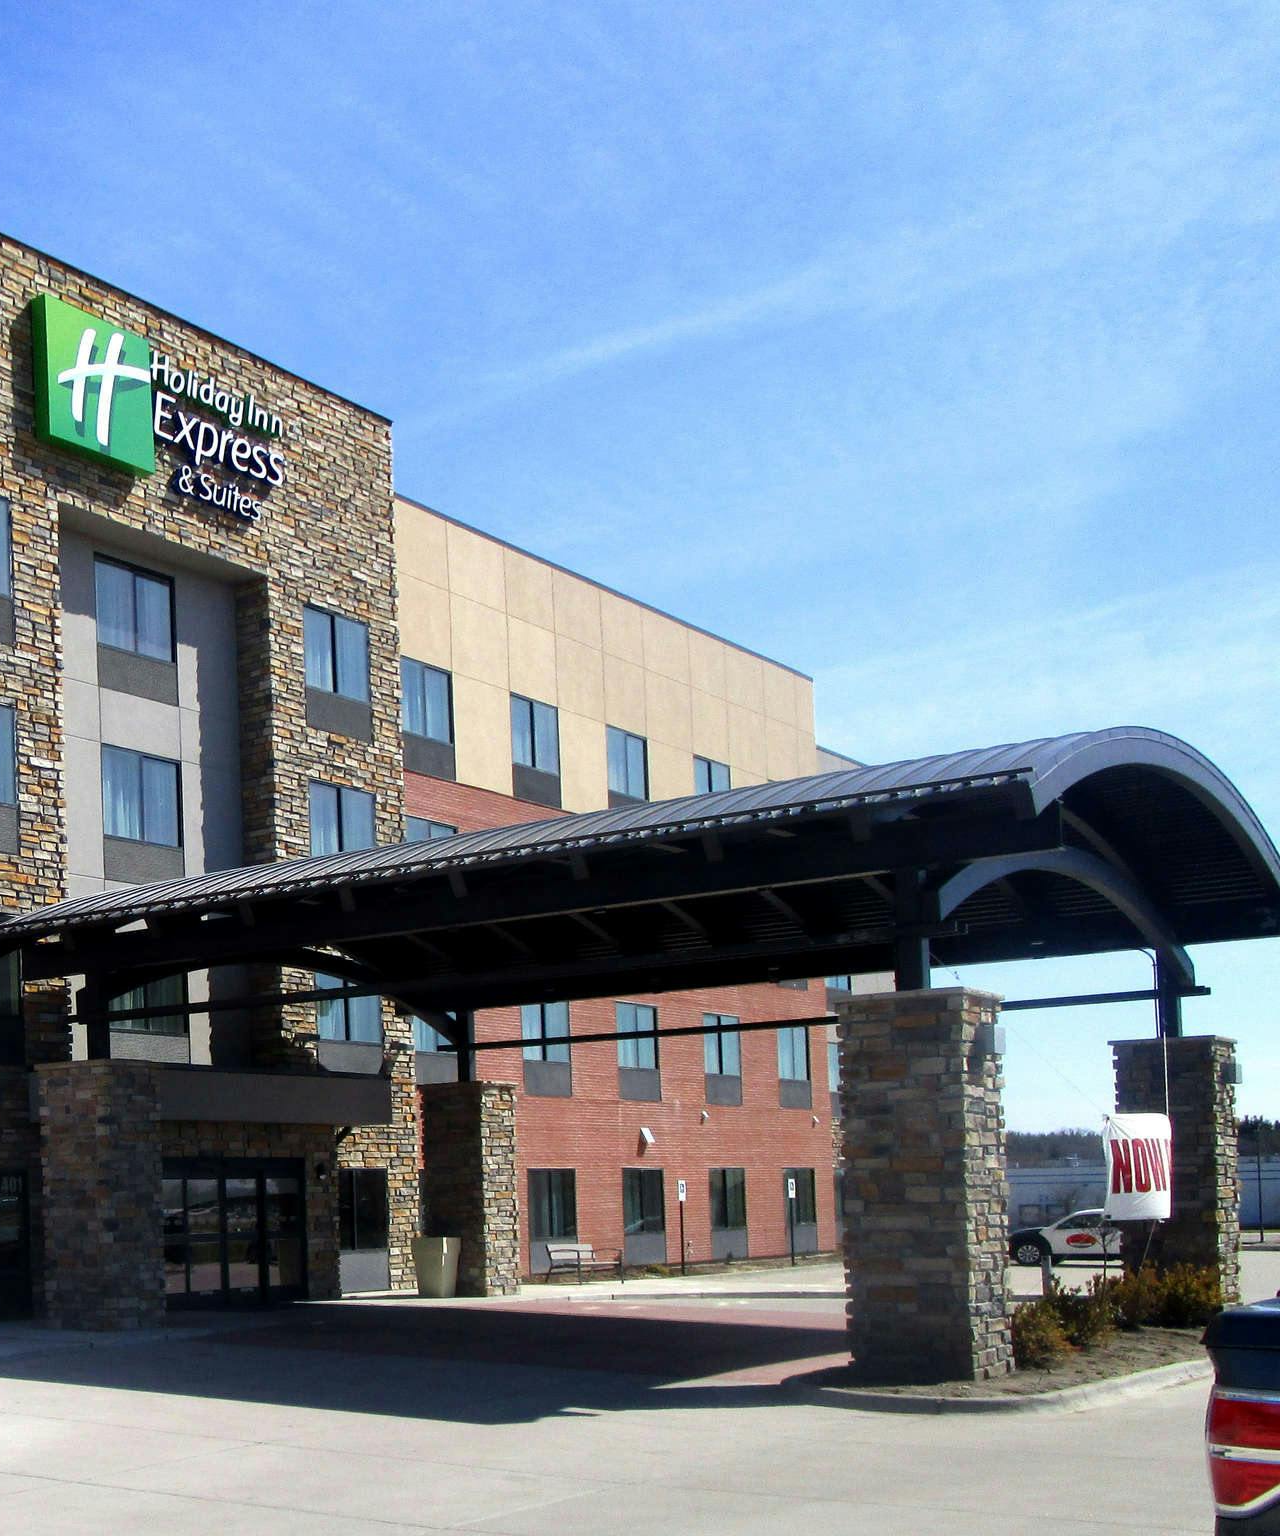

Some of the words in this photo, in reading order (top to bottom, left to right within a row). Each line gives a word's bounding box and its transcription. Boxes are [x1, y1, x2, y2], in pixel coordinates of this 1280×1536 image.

[150, 350, 244, 426] Holiday
[248, 393, 283, 438] Inn
[153, 391, 286, 487] Express
[178, 465, 195, 496] &
[200, 472, 262, 521] Suites
[1110, 1138, 1167, 1193] NOW
